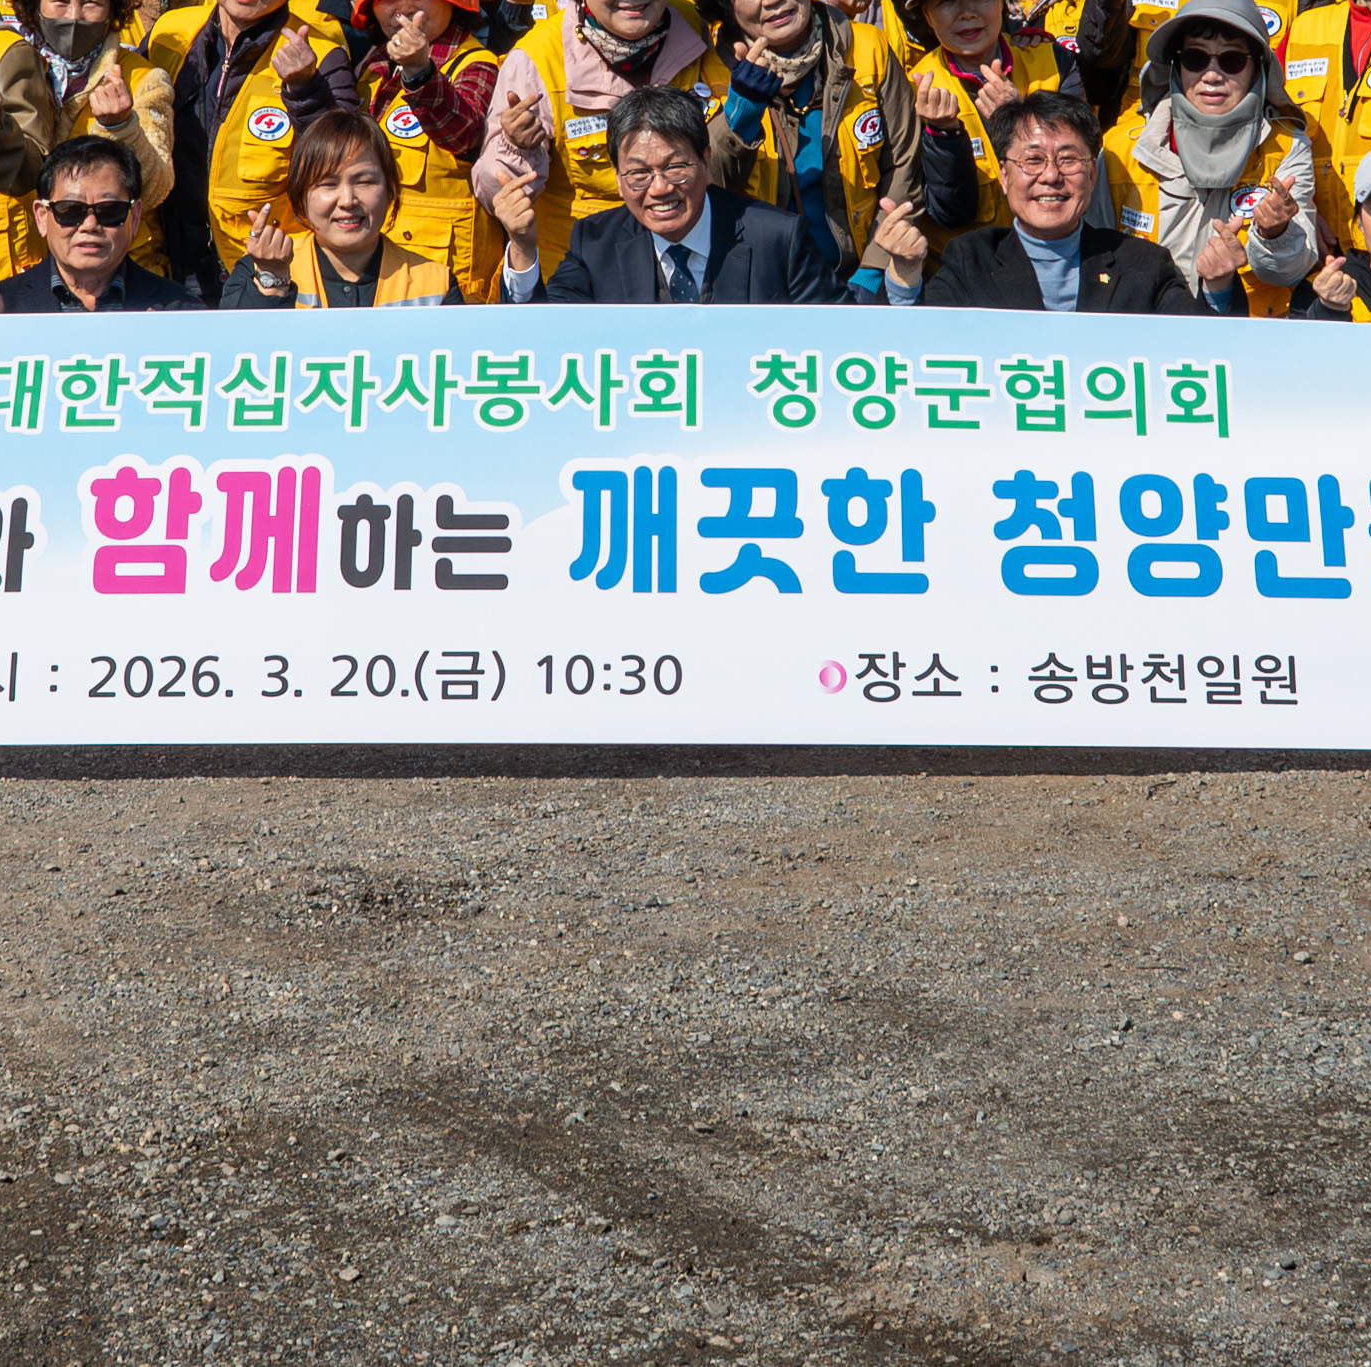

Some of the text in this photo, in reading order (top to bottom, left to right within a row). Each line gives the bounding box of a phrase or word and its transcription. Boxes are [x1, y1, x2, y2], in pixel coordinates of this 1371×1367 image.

[754, 354, 1229, 438] 청양군협의회
[90, 466, 513, 595] 함께하는
[569, 465, 936, 595] 깨끗한
[88, 655, 234, 698] 2026.
[261, 655, 303, 698] 3.
[330, 650, 506, 702] 20.(금)
[537, 654, 683, 696] 10:30
[855, 651, 962, 703] 장소
[1028, 652, 1298, 705] 송방천일원
